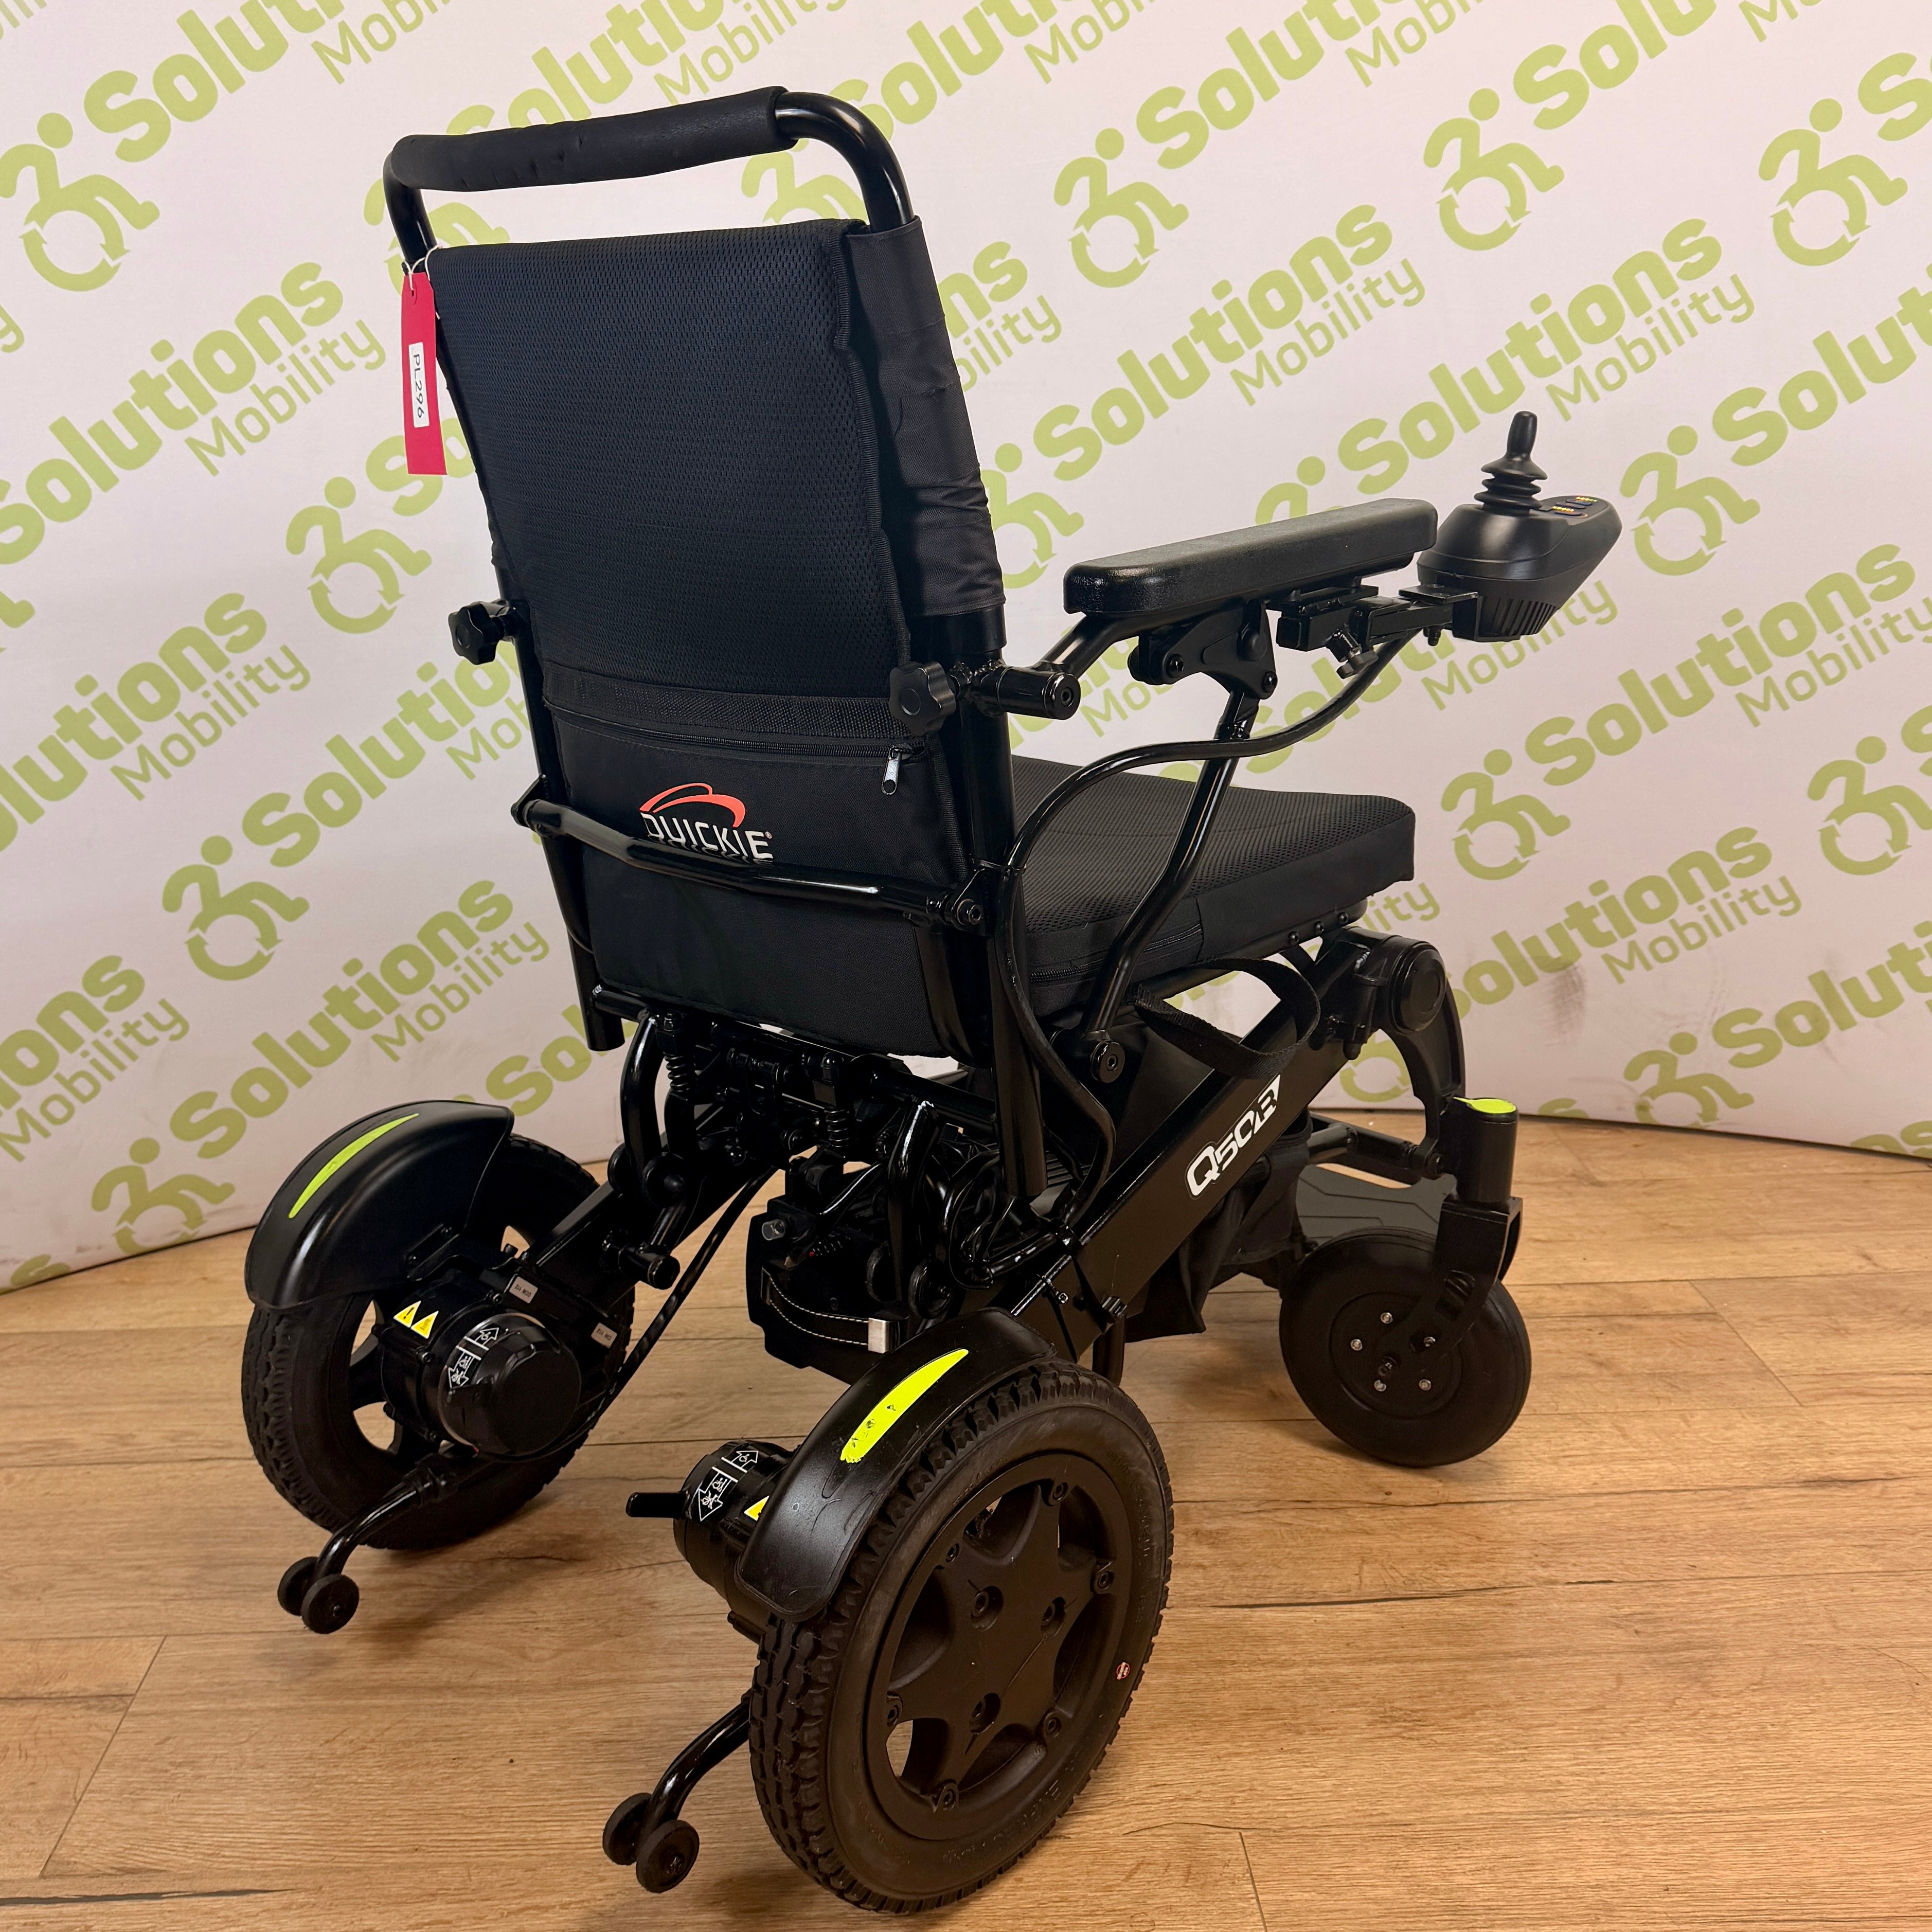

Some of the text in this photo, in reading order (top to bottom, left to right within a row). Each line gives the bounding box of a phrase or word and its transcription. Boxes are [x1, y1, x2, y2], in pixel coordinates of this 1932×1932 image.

[83, 0, 345, 163] Solut
[1135, 0, 1403, 170] Solut
[184, 320, 386, 476] Mobility
[413, 354, 425, 418] PL296
[1032, 204, 1393, 481] Solutions
[1229, 259, 1426, 406] Mobility
[1337, 218, 1722, 495] Solutions
[1546, 274, 1755, 421] Mobility
[0, 593, 267, 852] lutions
[110, 645, 311, 801] Mobility
[1524, 544, 1916, 787] Solutions
[370, 922, 550, 1063] Mobility
[1446, 826, 1773, 1021] olutions
[1601, 875, 1802, 984] Mobility
[0, 955, 146, 1111] ons
[0, 997, 190, 1162] Mobility
[169, 880, 513, 1160] Solutions
